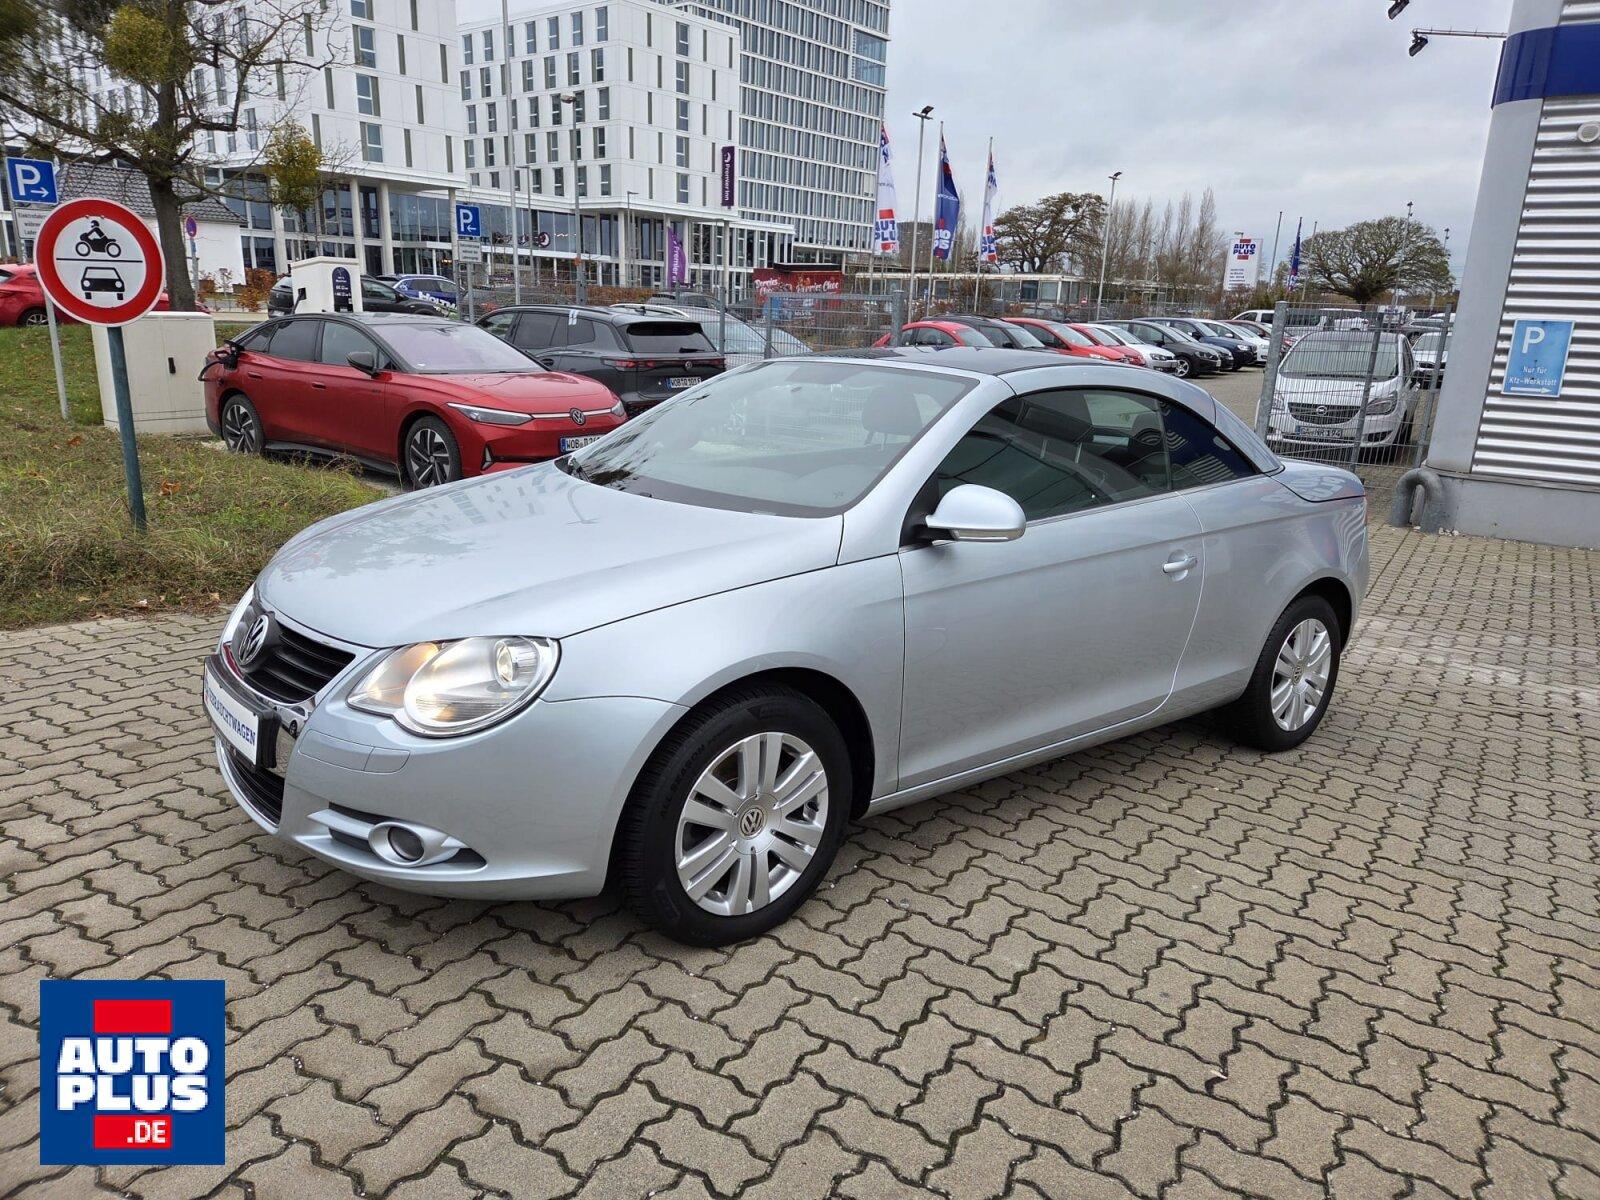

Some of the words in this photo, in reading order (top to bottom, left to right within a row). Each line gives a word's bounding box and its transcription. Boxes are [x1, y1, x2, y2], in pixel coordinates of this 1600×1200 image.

[14, 164, 41, 196] P
[459, 208, 473, 232] P
[672, 245, 680, 275] Premier
[1521, 326, 1545, 354] P
[1507, 377, 1557, 386] Kfz-Werkstatt
[1522, 366, 1534, 374] Nur
[1536, 366, 1548, 374] für
[566, 438, 580, 449] WOB
